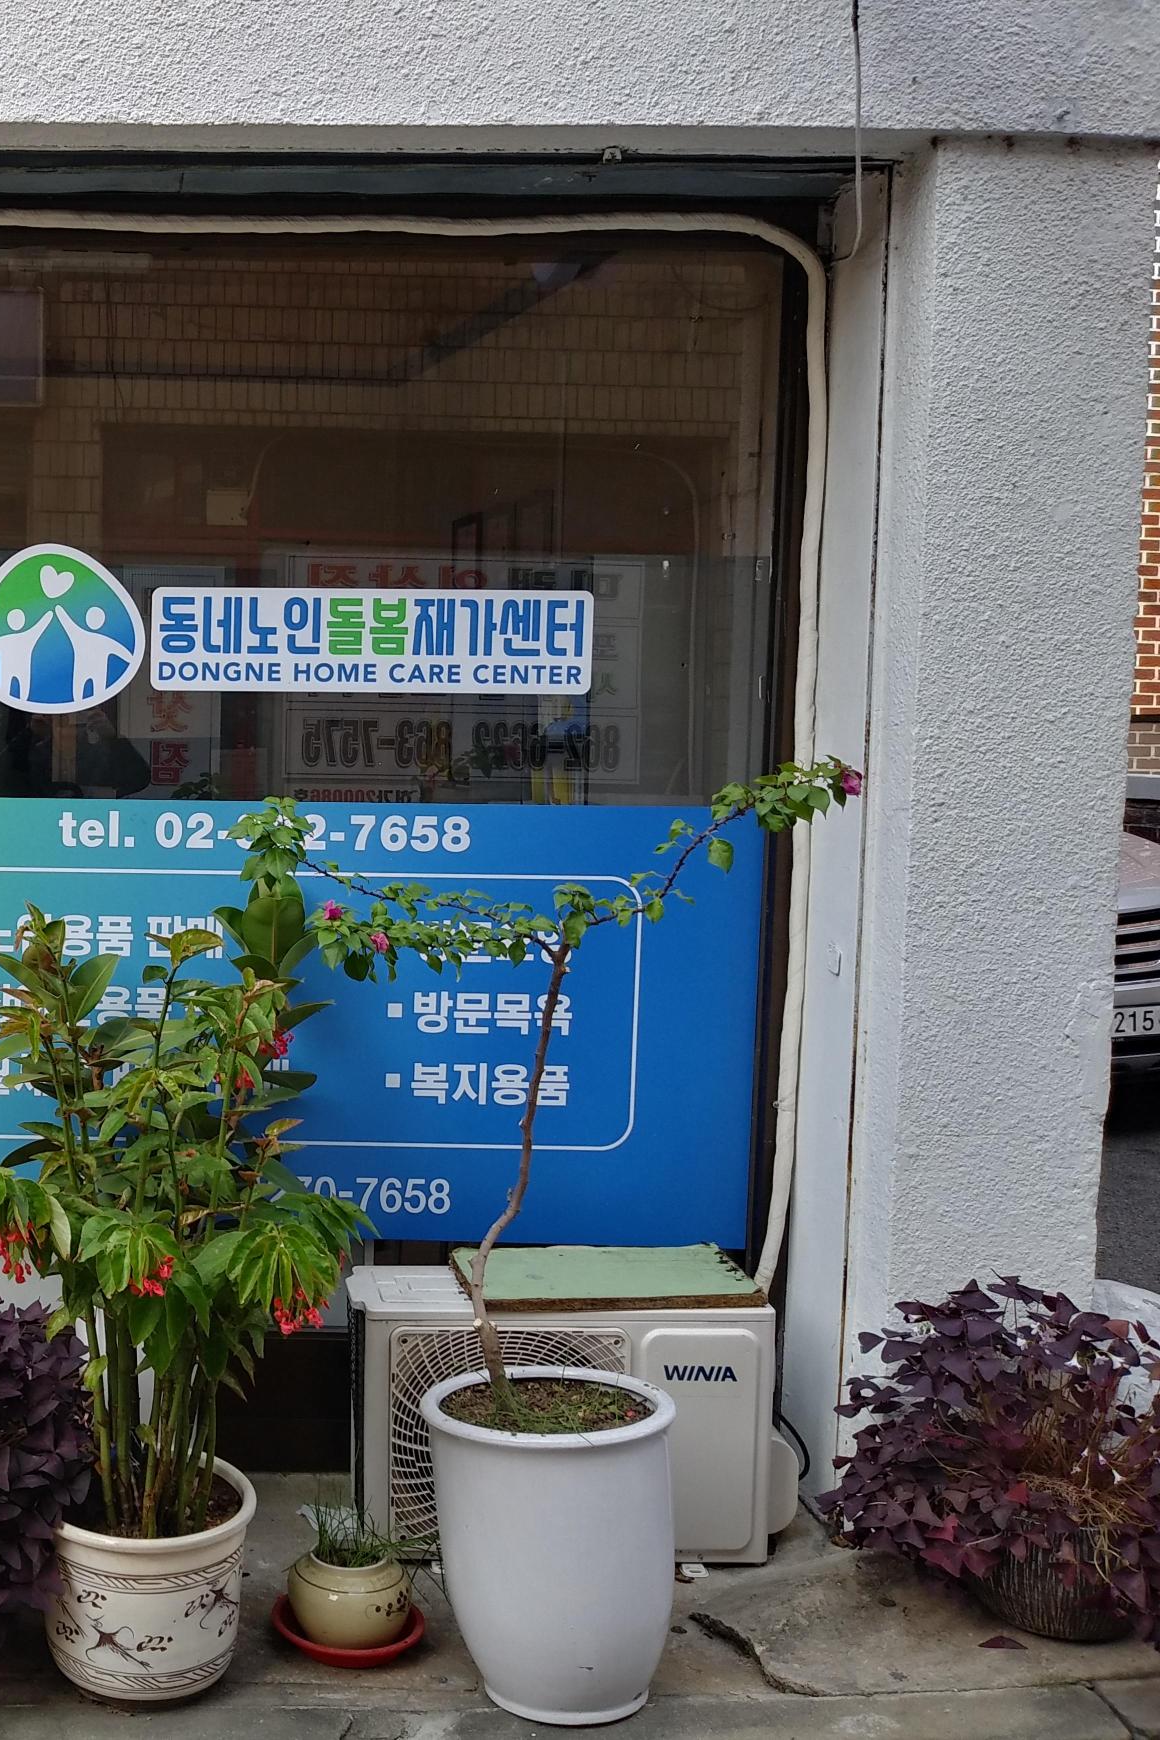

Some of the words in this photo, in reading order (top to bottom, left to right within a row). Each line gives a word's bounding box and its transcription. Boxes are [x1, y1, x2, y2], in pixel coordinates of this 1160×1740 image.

[158, 596, 584, 659] 동네노인돌봄재가센터
[158, 661, 282, 683] DONGNE
[293, 662, 378, 684] HOME
[389, 663, 462, 684] CARE
[472, 664, 582, 685] CENTER
[58, 810, 135, 848] tel.
[155, 811, 471, 853] 02-2-7658
[413, 991, 573, 1035] 방문목욕
[411, 1063, 570, 1107] 복지용품
[663, 1364, 738, 1382] WINIA
